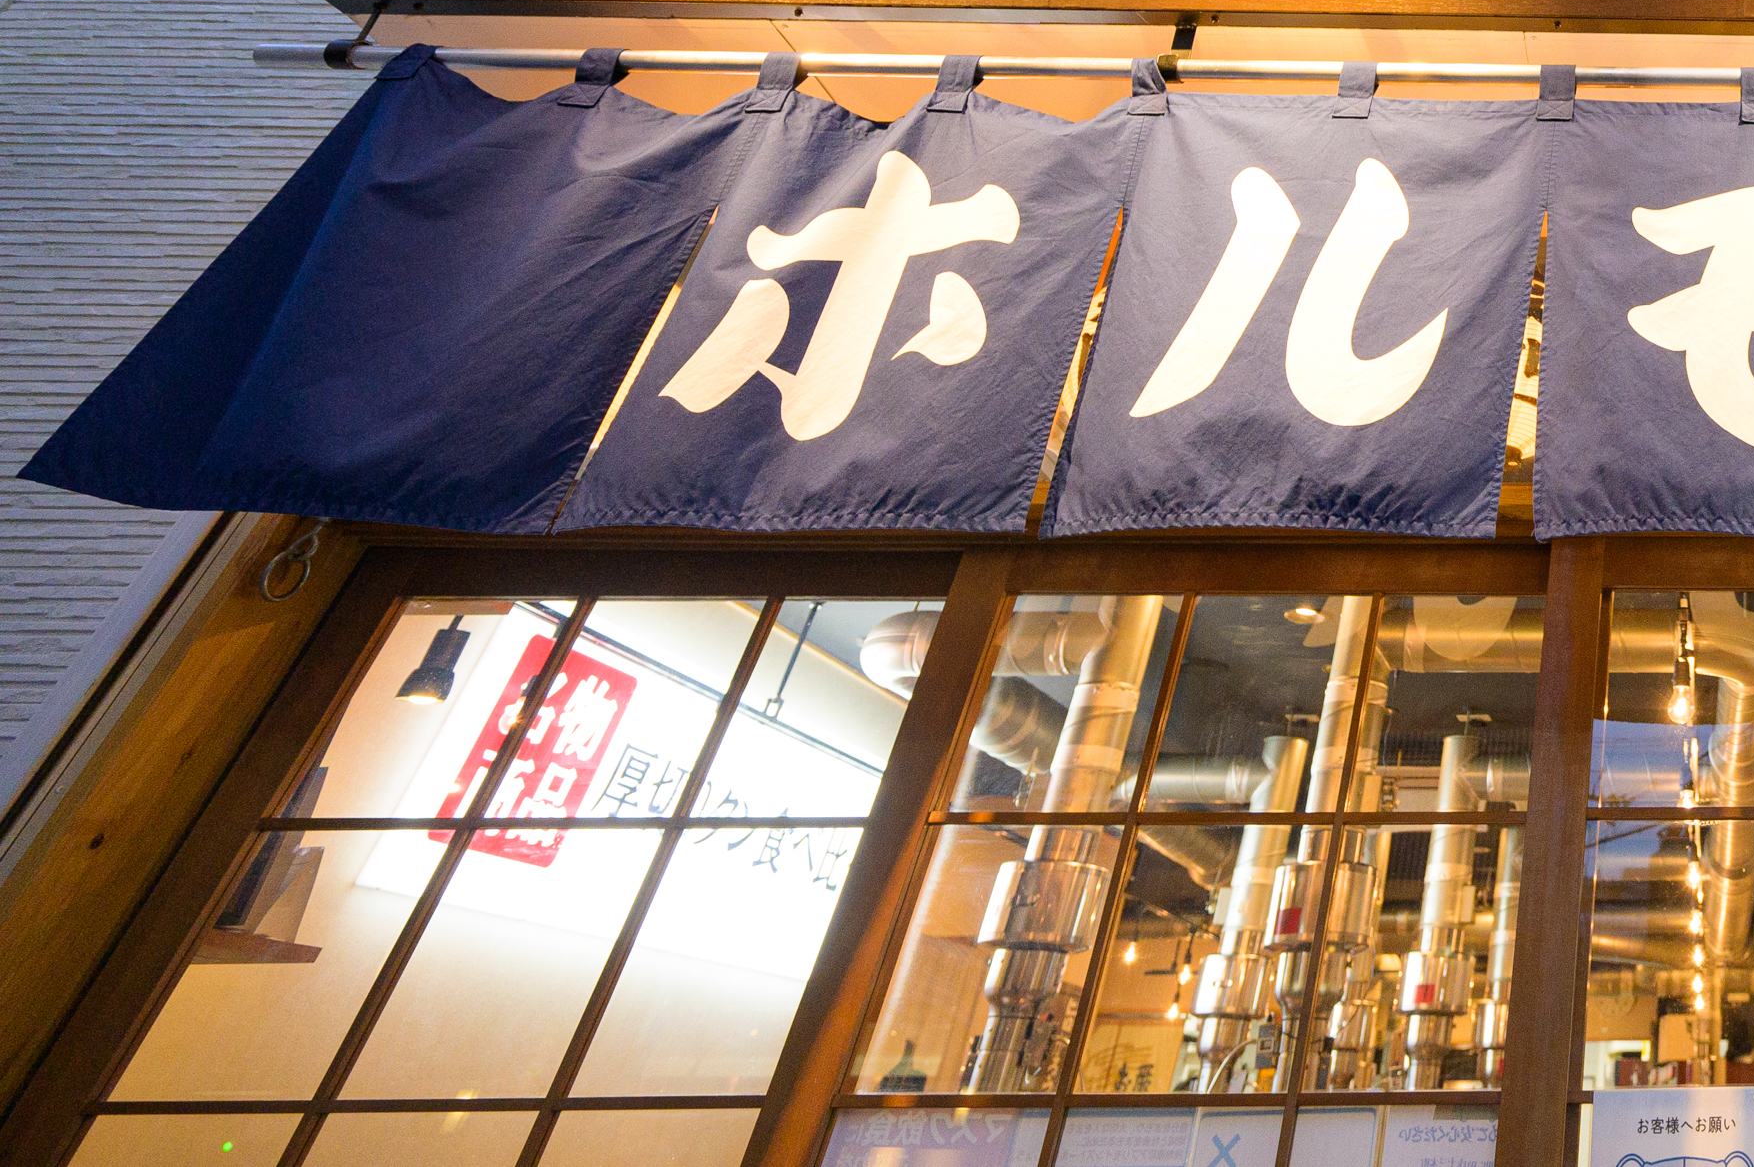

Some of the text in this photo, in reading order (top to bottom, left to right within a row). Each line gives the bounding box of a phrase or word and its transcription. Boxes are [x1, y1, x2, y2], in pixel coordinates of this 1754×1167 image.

[1636, 1116, 1737, 1135] お客様へお願い
